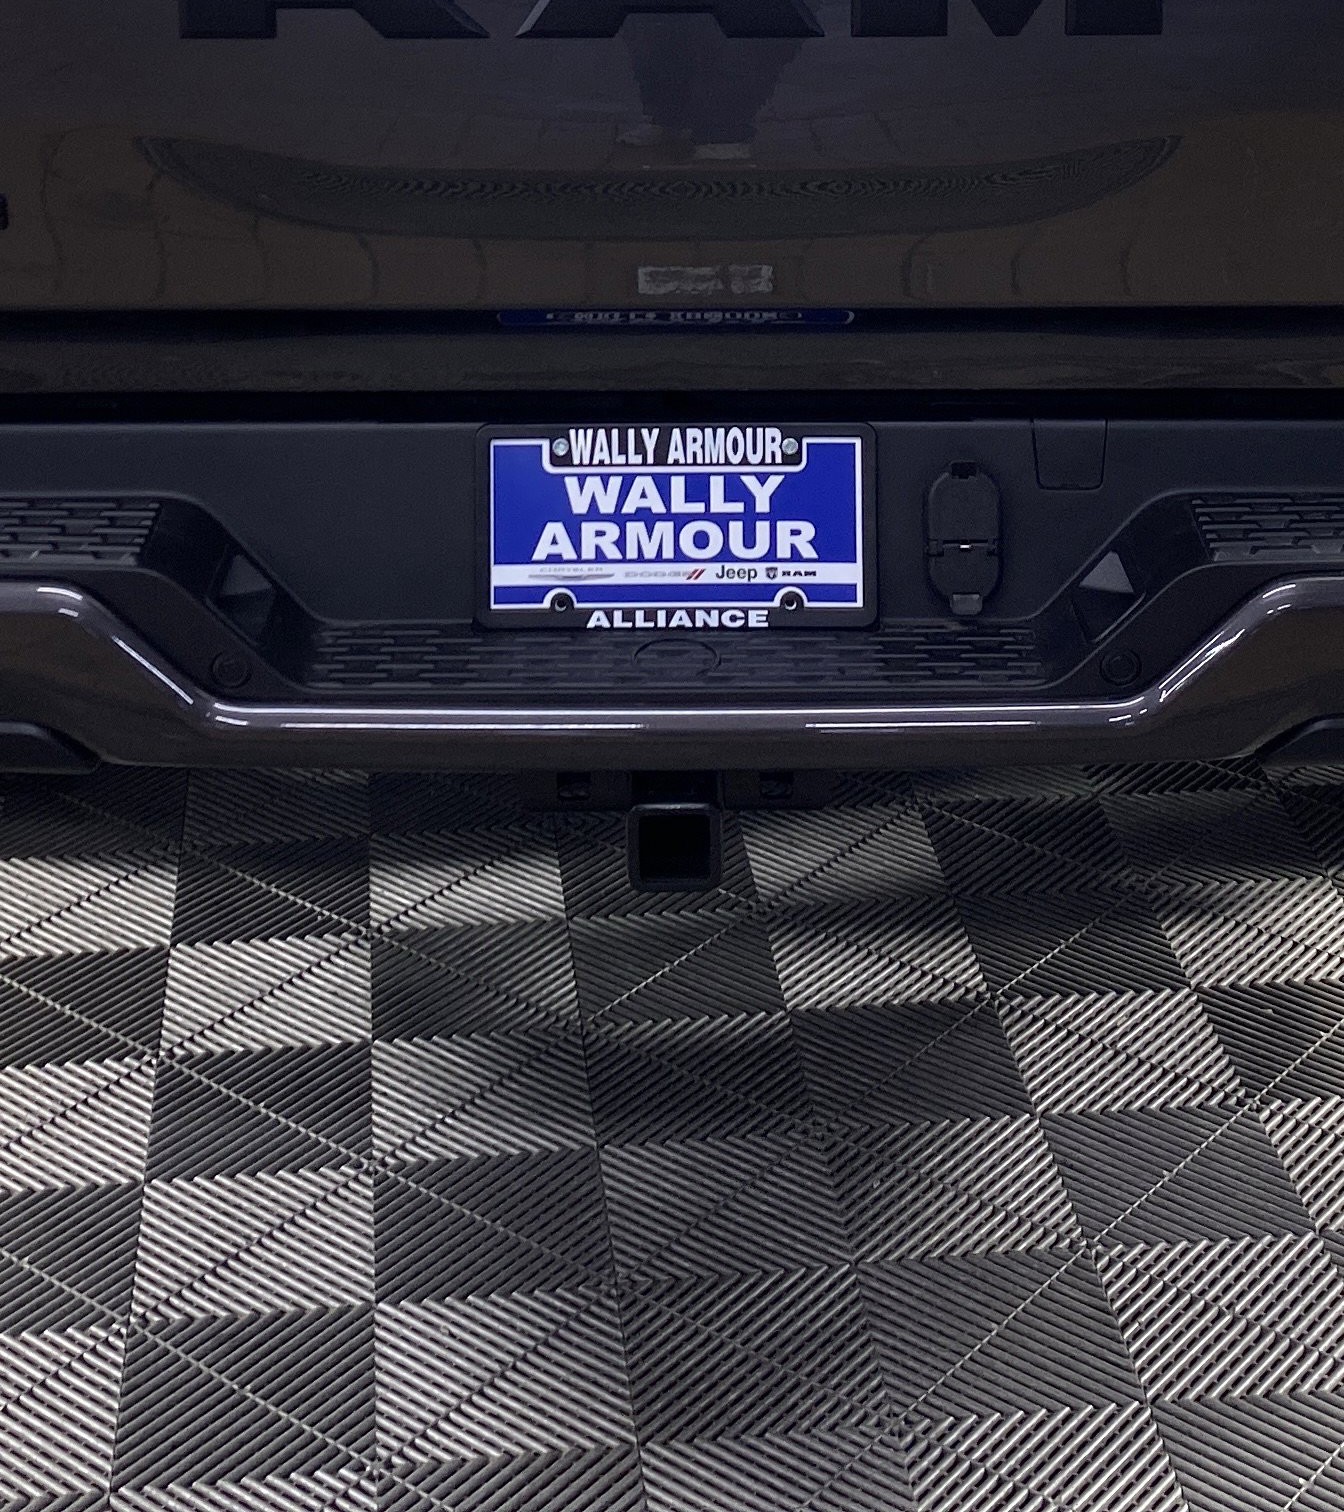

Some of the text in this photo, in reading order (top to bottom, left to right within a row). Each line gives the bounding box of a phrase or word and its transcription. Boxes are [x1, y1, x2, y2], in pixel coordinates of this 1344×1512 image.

[569, 426, 783, 465] WALLY ARMOUR
[563, 474, 785, 515] WALLY
[530, 520, 819, 561] ARMOUR
[715, 564, 758, 582] Jeep
[586, 609, 769, 629] ALLIANCE
